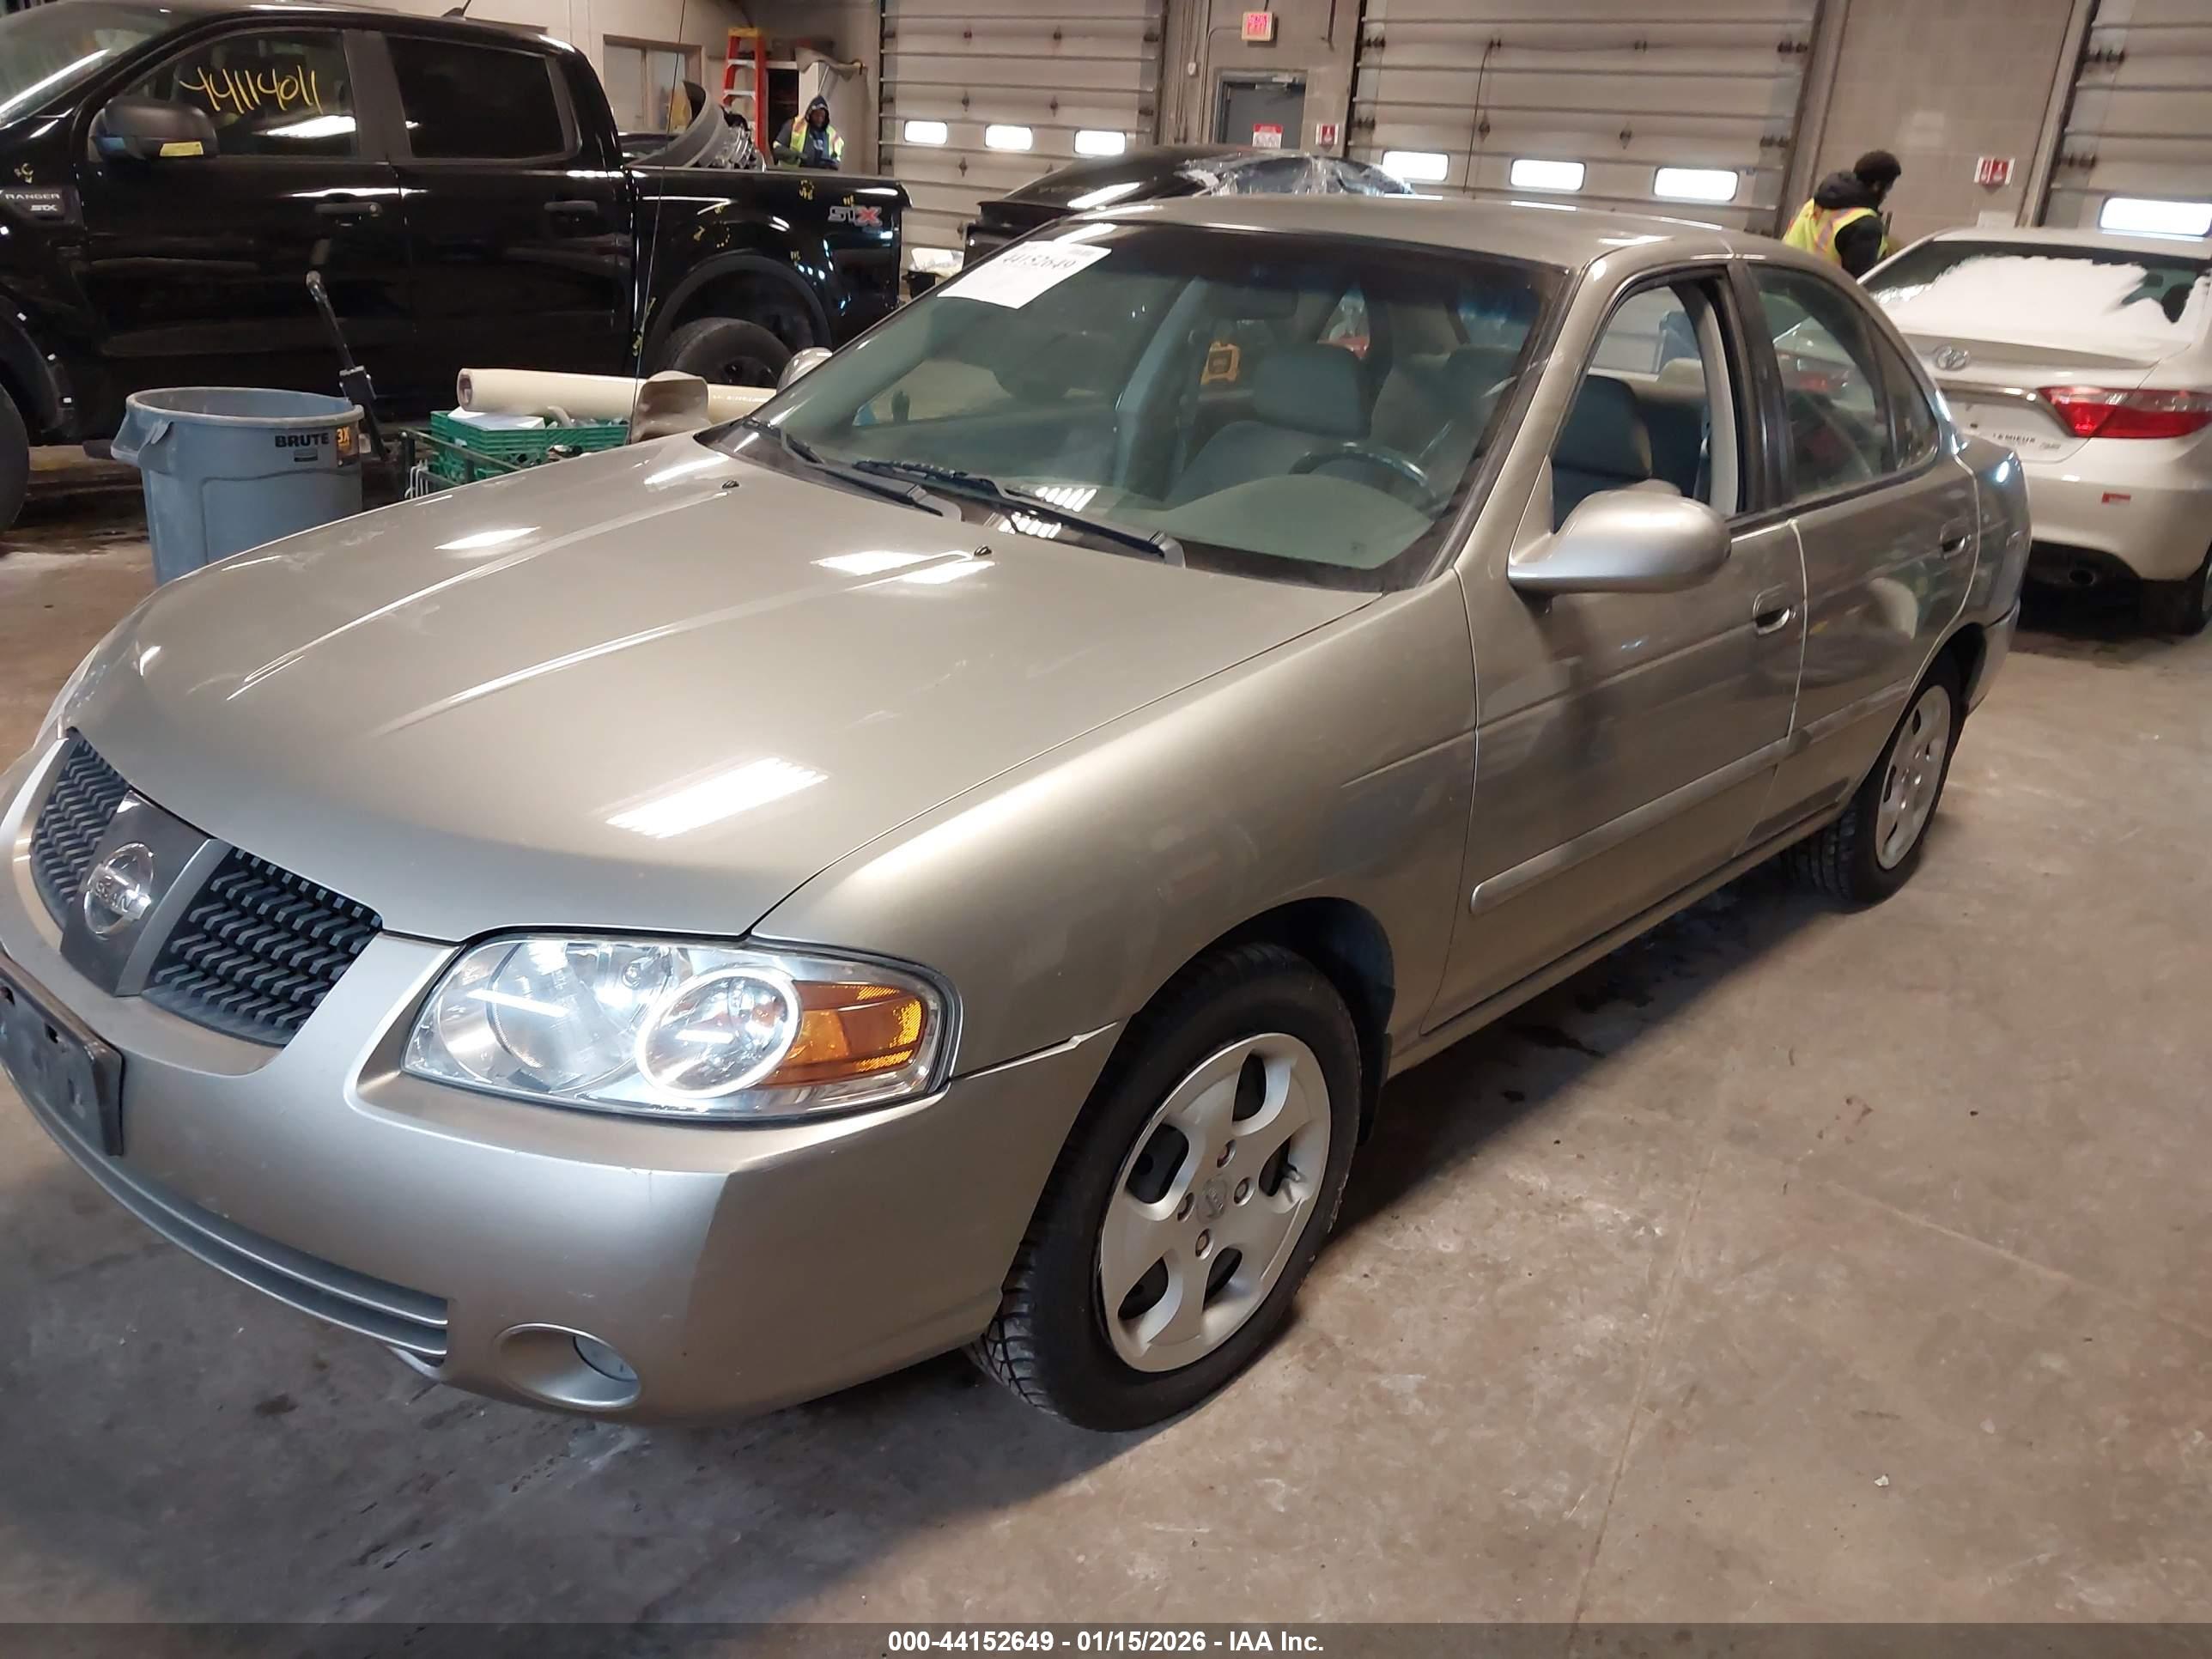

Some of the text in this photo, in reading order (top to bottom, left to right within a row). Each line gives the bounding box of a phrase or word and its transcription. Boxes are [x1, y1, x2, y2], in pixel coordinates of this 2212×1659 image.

[179, 64, 324, 115] 44114011
[827, 205, 884, 227] STX
[274, 432, 331, 448] BRUTE
